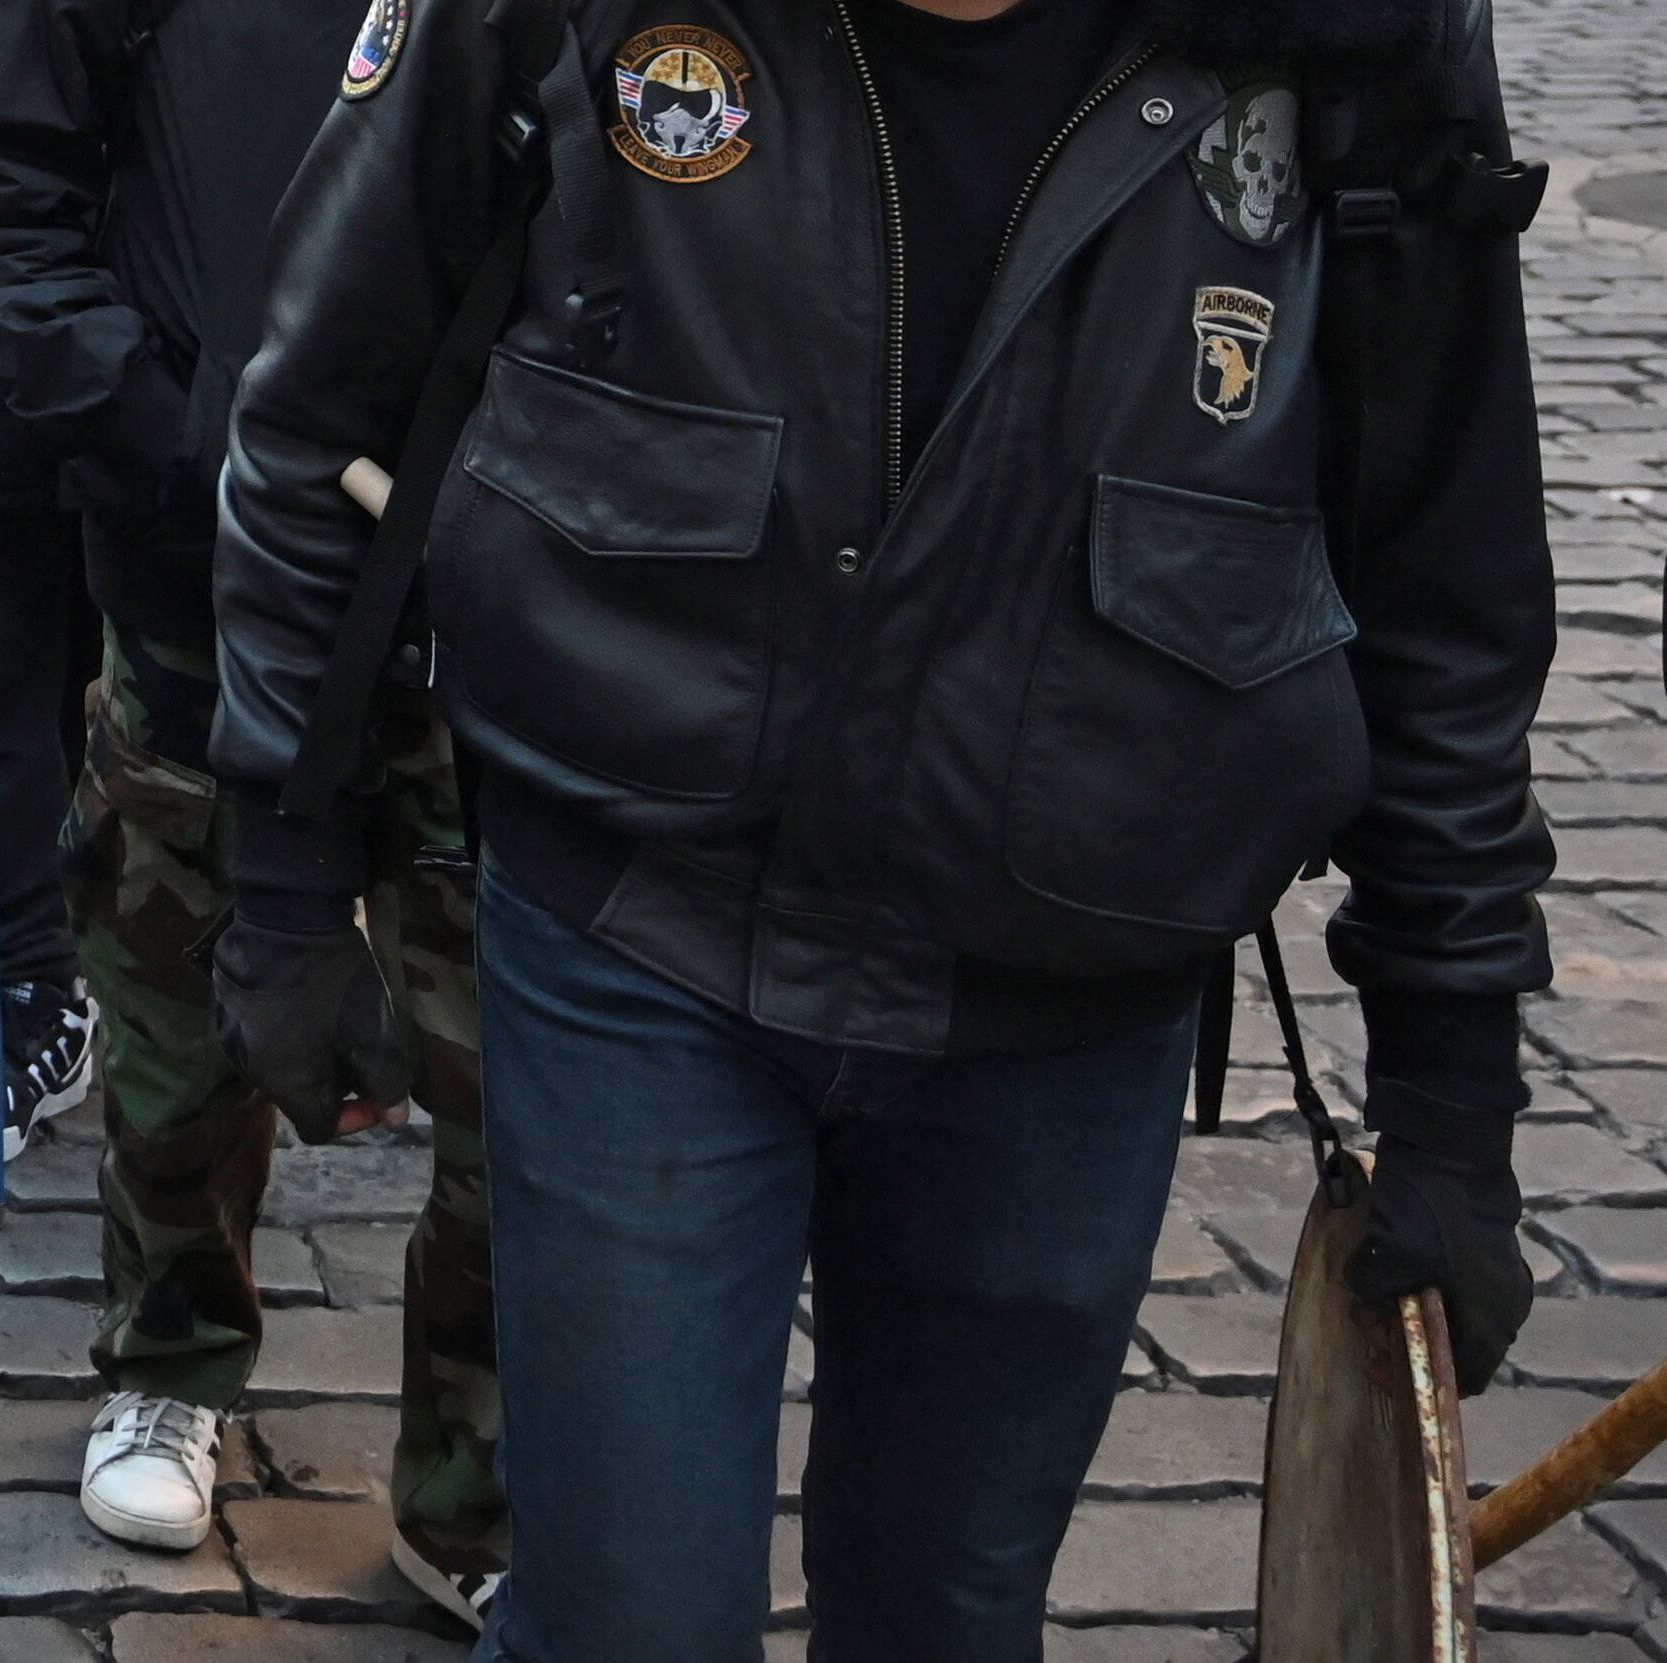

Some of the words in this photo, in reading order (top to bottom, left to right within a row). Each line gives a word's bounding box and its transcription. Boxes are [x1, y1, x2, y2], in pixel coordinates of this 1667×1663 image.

[627, 39, 652, 60] YOU
[656, 31, 701, 45] NEVER
[704, 38, 744, 69] NEVER
[618, 133, 650, 165] LEAVE
[653, 160, 681, 177] YOUR
[687, 142, 745, 176] WINGMAN
[1201, 294, 1271, 323] AIRBORNE
